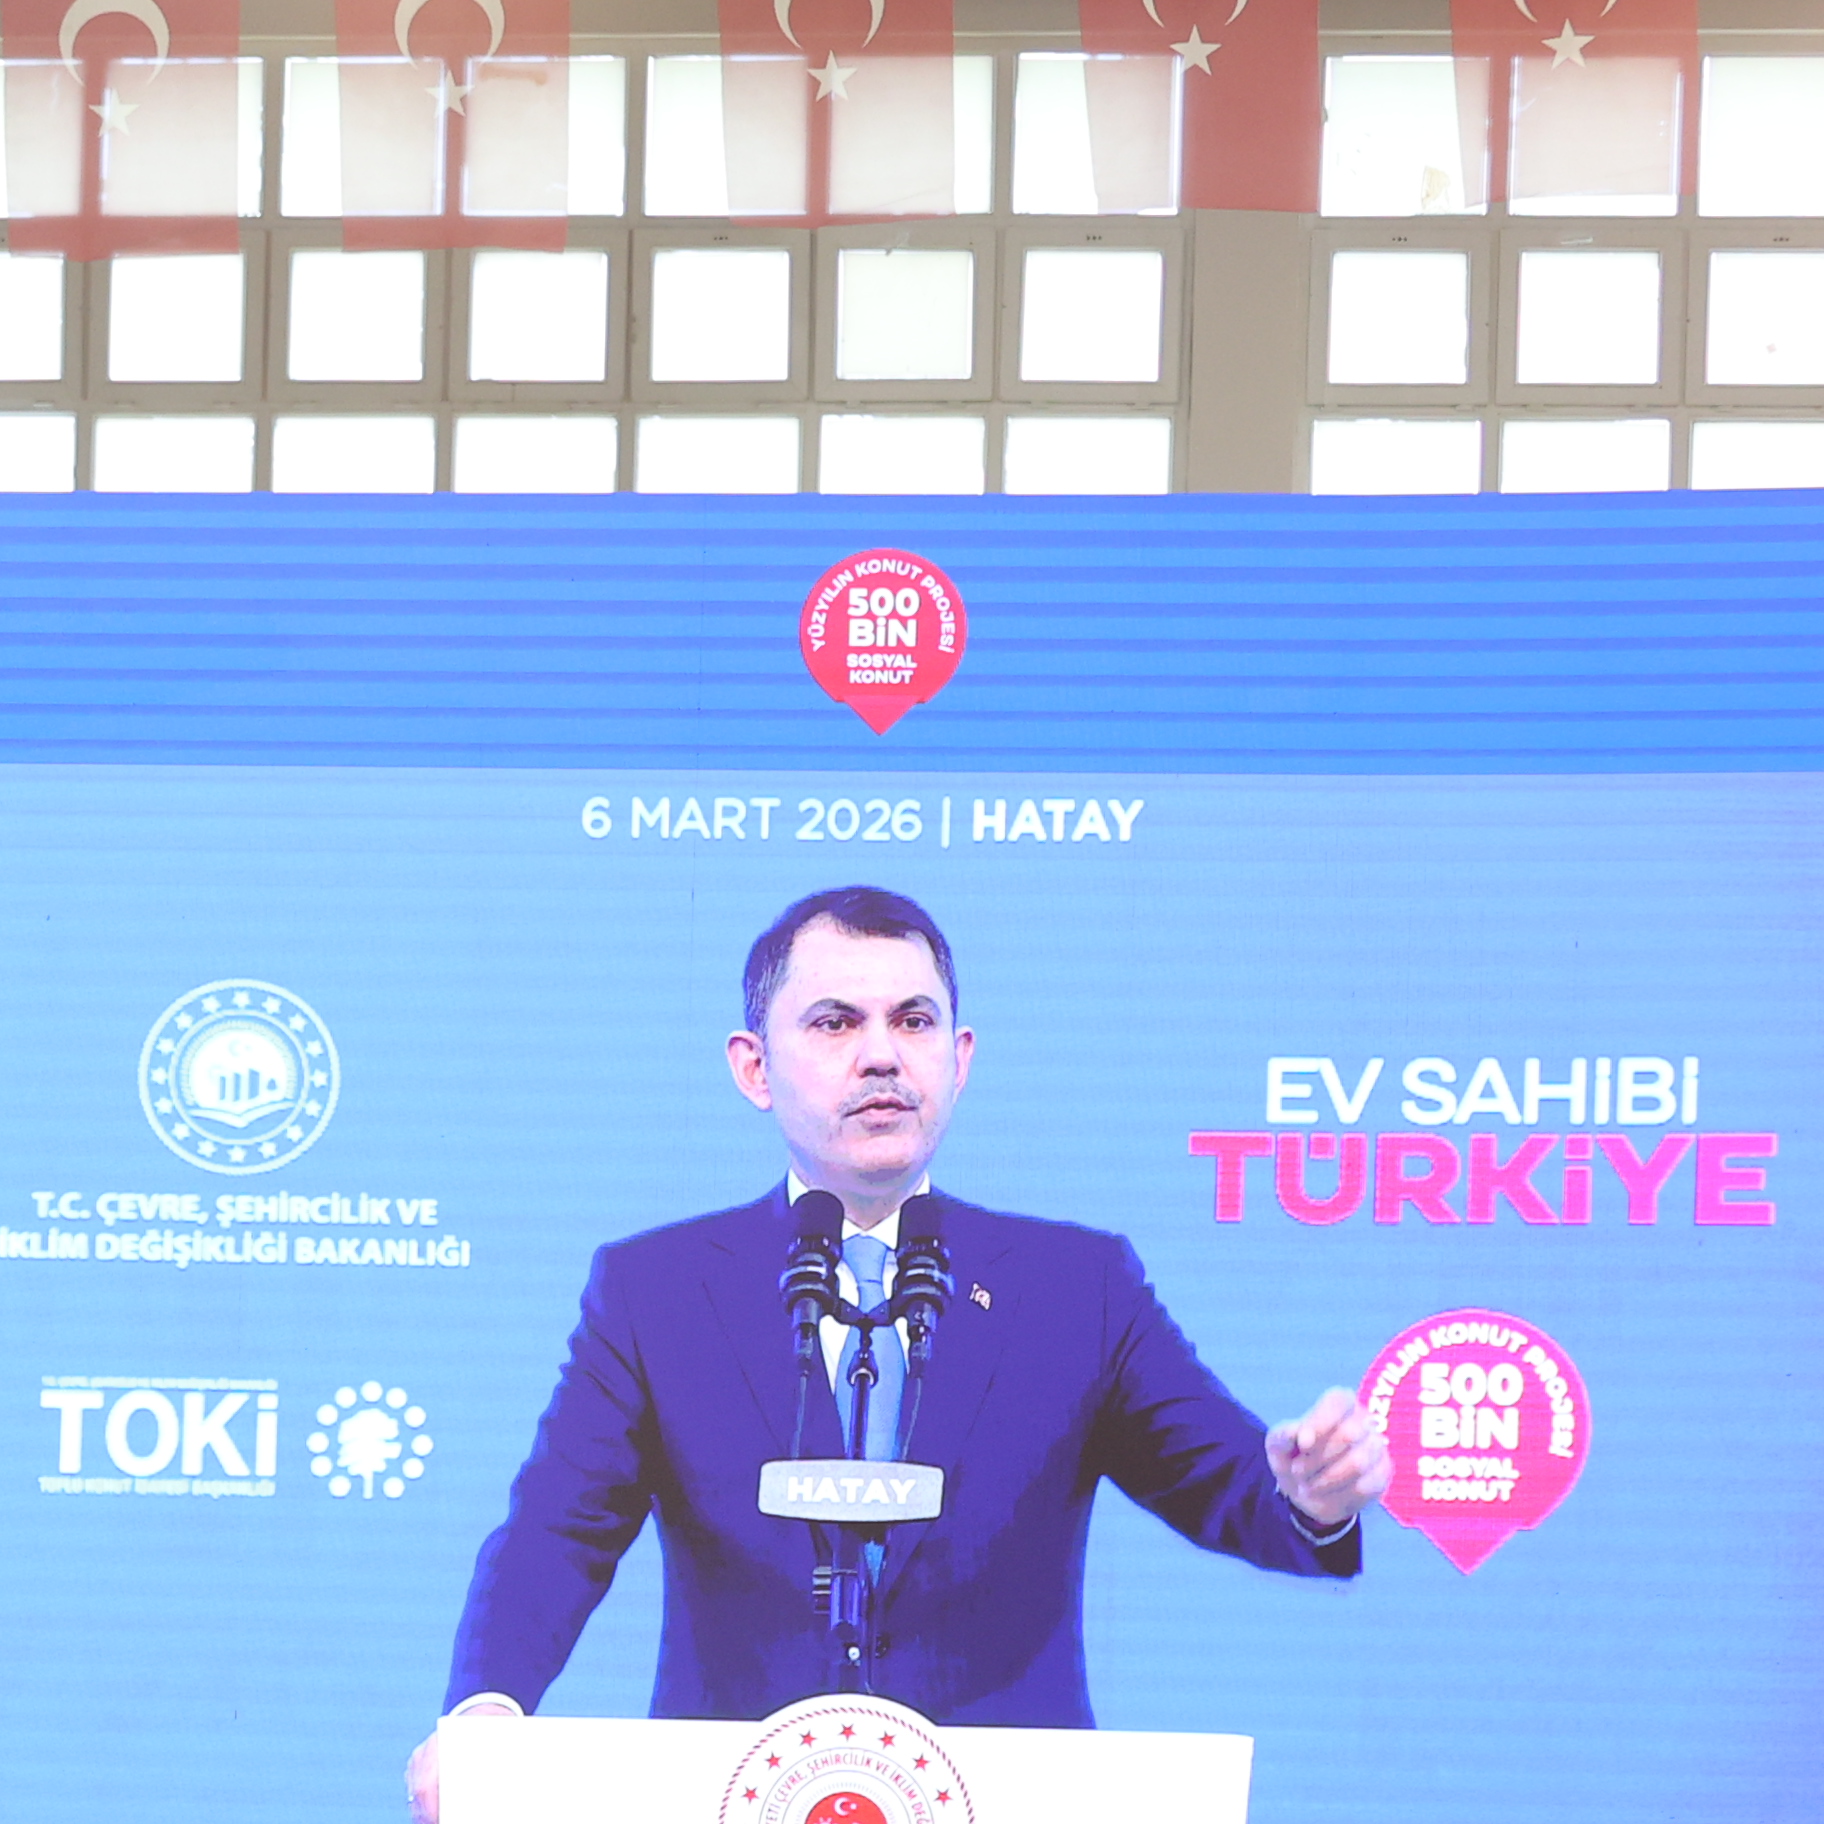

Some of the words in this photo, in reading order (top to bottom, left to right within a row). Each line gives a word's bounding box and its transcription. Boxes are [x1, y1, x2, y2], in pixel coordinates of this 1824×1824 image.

[807, 569, 854, 652] YÜZYILIN
[855, 558, 923, 580] KONUT
[847, 587, 920, 617] 500
[846, 653, 918, 668] SOSYAL
[849, 669, 914, 684] KONUT
[581, 796, 613, 839] 6
[630, 796, 781, 840] MART
[795, 799, 922, 843] 2026
[972, 799, 1143, 843] HATAY
[1266, 1057, 1385, 1124] EV
[31, 1191, 91, 1221] T.C.
[96, 1192, 209, 1227] ÇEVRE,
[215, 1191, 391, 1229] ŞEHİRCİLİK
[396, 1198, 438, 1226] VE
[95, 1229, 287, 1269] DEĞİŞİKLİĞİ
[295, 1235, 471, 1268] BAKANLIĞI
[1429, 1322, 1529, 1353] KONUT
[1418, 1362, 1524, 1406] 500
[787, 1476, 917, 1504] HATAY
[1422, 1478, 1515, 1501] KONUT
